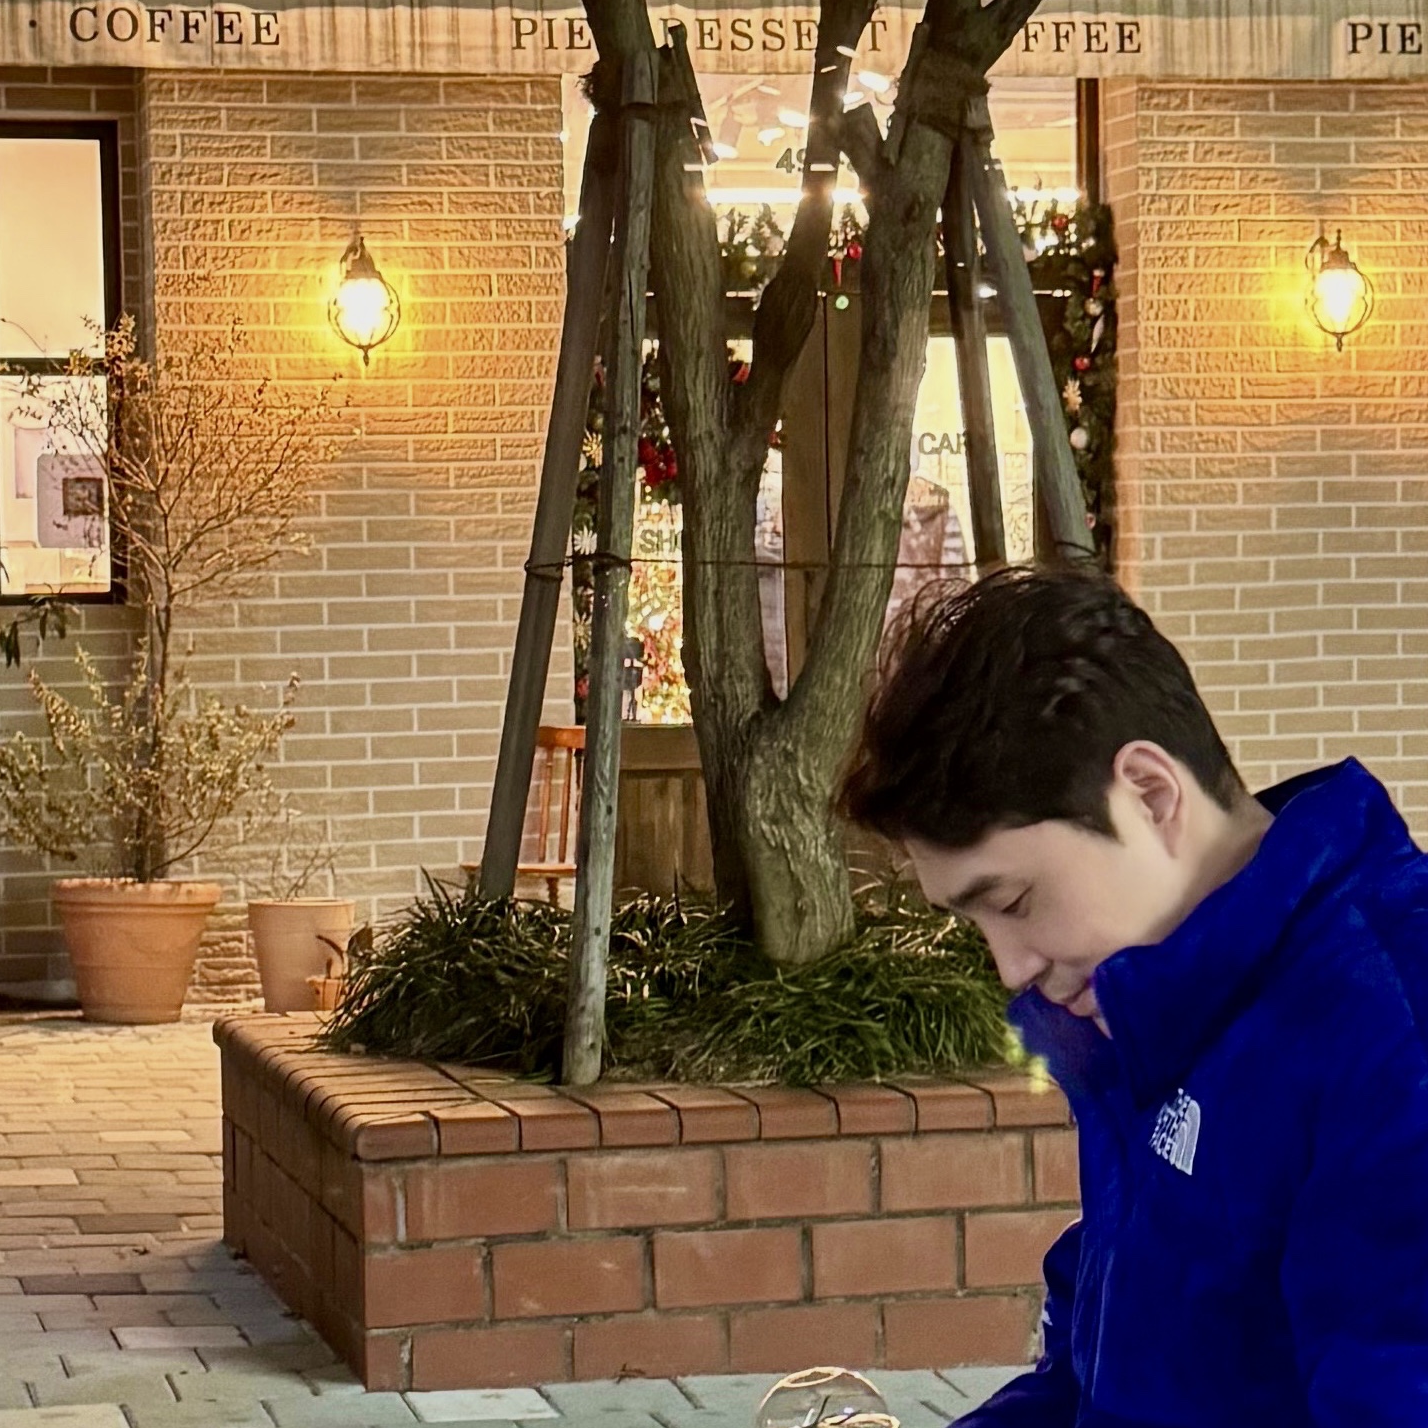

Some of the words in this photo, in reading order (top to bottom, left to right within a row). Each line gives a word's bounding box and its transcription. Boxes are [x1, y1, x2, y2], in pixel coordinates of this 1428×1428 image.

[69, 5, 283, 47] COFFEE
[511, 16, 592, 51] PIE
[659, 17, 887, 53] DESSET
[1023, 20, 1142, 54] FFEE
[1347, 21, 1423, 56] PIE
